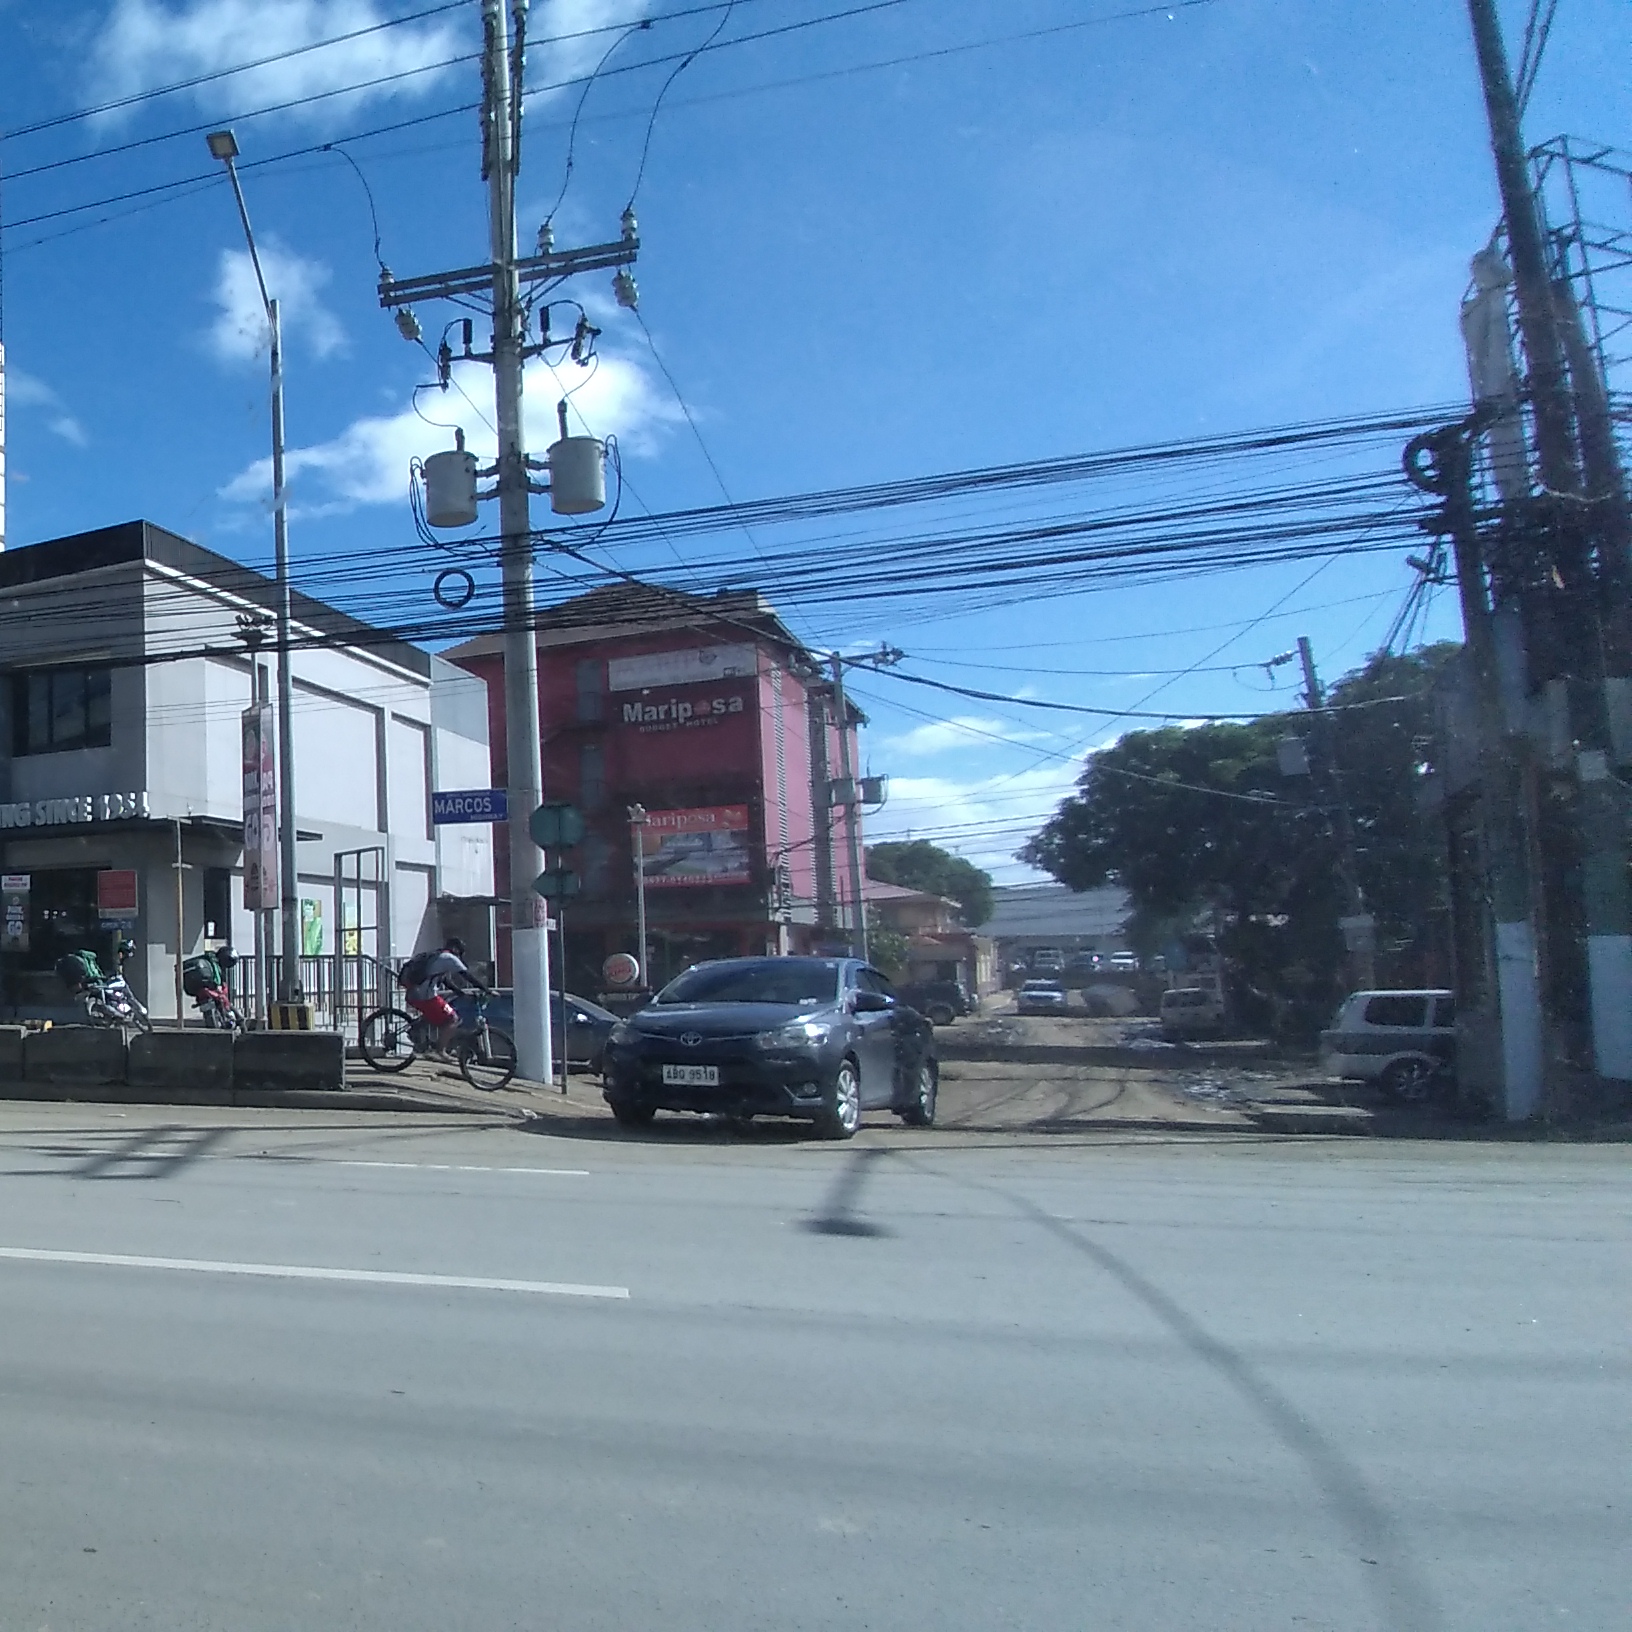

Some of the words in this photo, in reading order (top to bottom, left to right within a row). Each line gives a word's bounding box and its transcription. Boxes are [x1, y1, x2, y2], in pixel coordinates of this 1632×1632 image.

[34, 796, 93, 826] SINCE
[434, 797, 492, 814] MARCOS
[646, 811, 716, 829] ariposa
